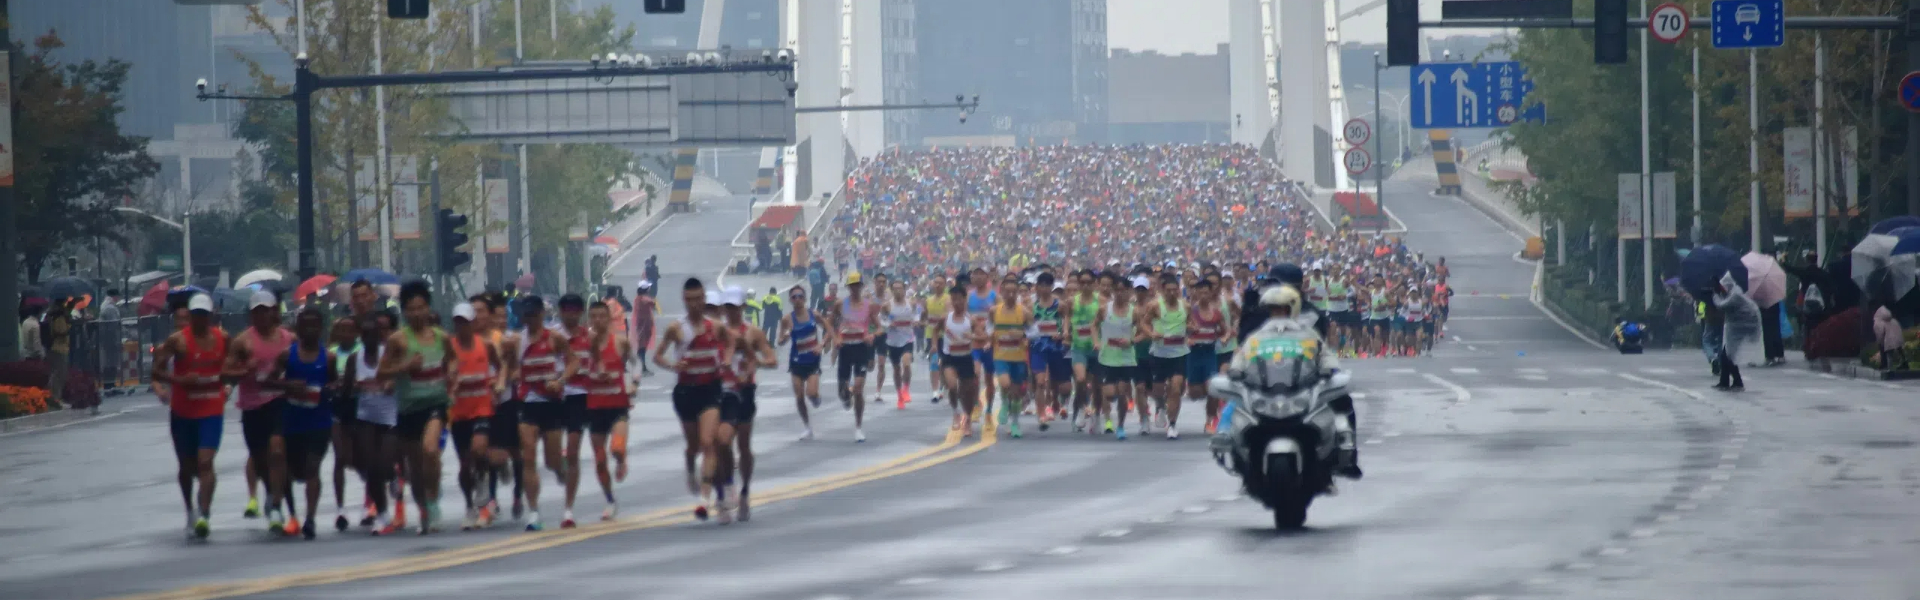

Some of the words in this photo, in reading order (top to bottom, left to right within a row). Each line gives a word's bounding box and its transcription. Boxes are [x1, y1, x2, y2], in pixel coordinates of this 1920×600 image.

[1658, 14, 1681, 32] 70
[1499, 63, 1514, 103] 小型车
